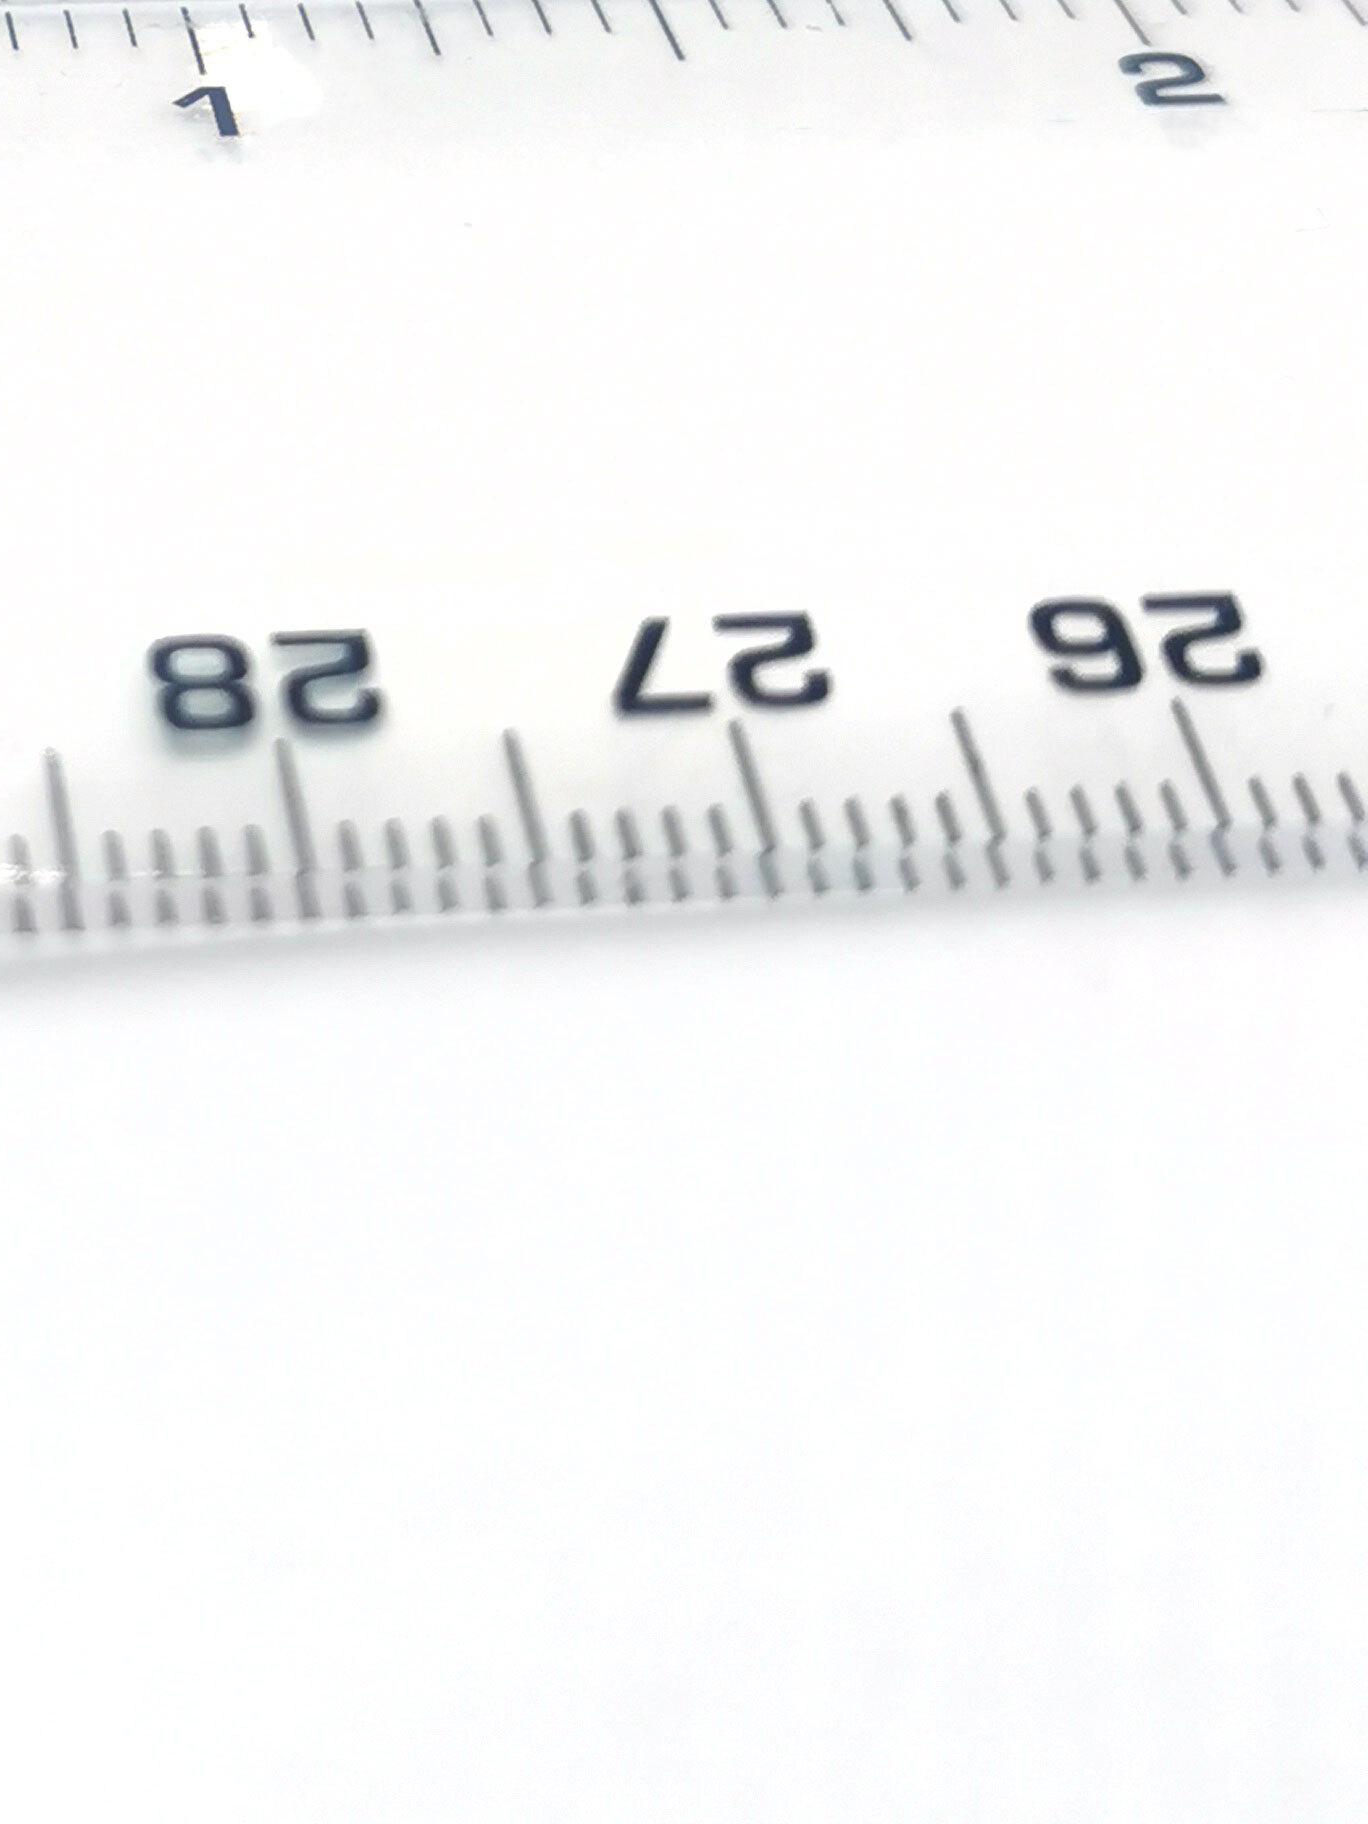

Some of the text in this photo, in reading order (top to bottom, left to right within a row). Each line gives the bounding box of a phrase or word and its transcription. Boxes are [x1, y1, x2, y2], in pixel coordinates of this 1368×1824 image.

[173, 86, 240, 137] 1
[1119, 52, 1225, 106] 2
[149, 630, 383, 736] 28
[614, 613, 831, 717] 27
[1029, 593, 1264, 694] 26
